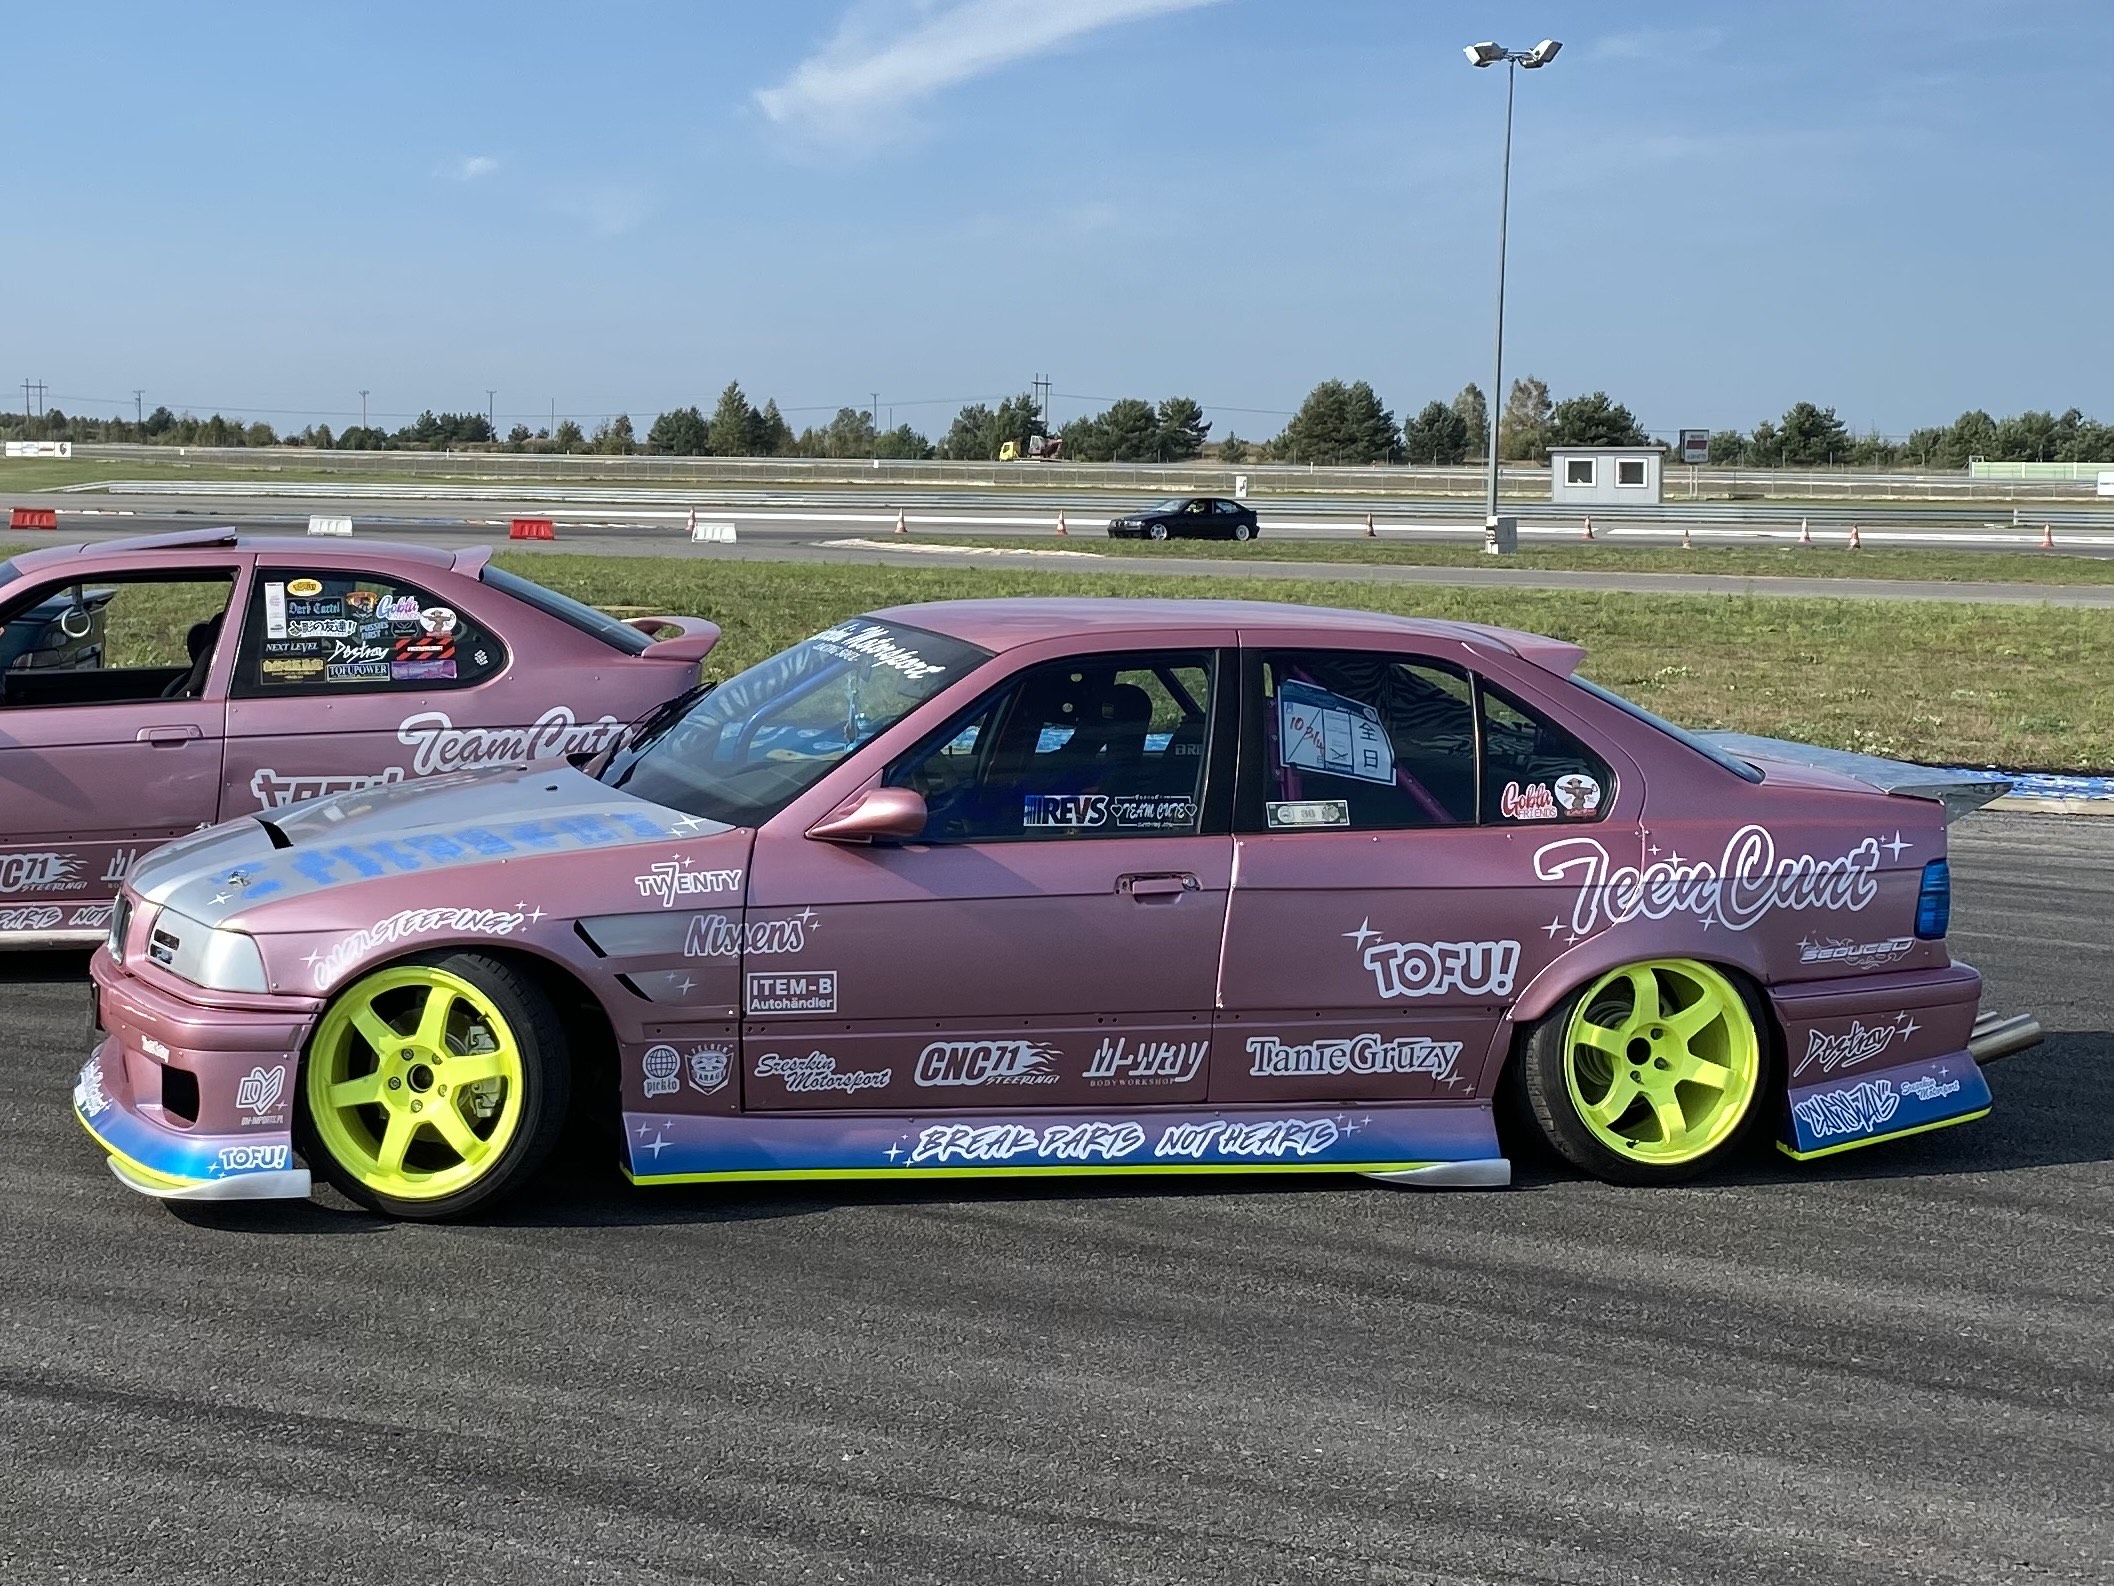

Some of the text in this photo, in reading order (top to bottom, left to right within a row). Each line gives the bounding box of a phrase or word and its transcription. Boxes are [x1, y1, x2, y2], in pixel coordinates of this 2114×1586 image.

[289, 601, 311, 615] Dark
[313, 601, 340, 615] Cartel
[266, 642, 319, 653] NEXT LEVEL
[330, 664, 387, 677] TOFUPOWER
[1045, 796, 1109, 826] REVS
[1123, 803, 1155, 819] TEAM
[1518, 807, 1557, 819] FRIENDS
[1364, 940, 1521, 998] TOFU!
[752, 978, 833, 996] ITEM-B
[750, 997, 833, 1010] Autohändler
[914, 1041, 1028, 1087] CNC71
[785, 1068, 892, 1094] Motorsport
[912, 1118, 1339, 1162] BREAK PARTS NOT HEARTS
[219, 1144, 288, 1170] TOFU!
